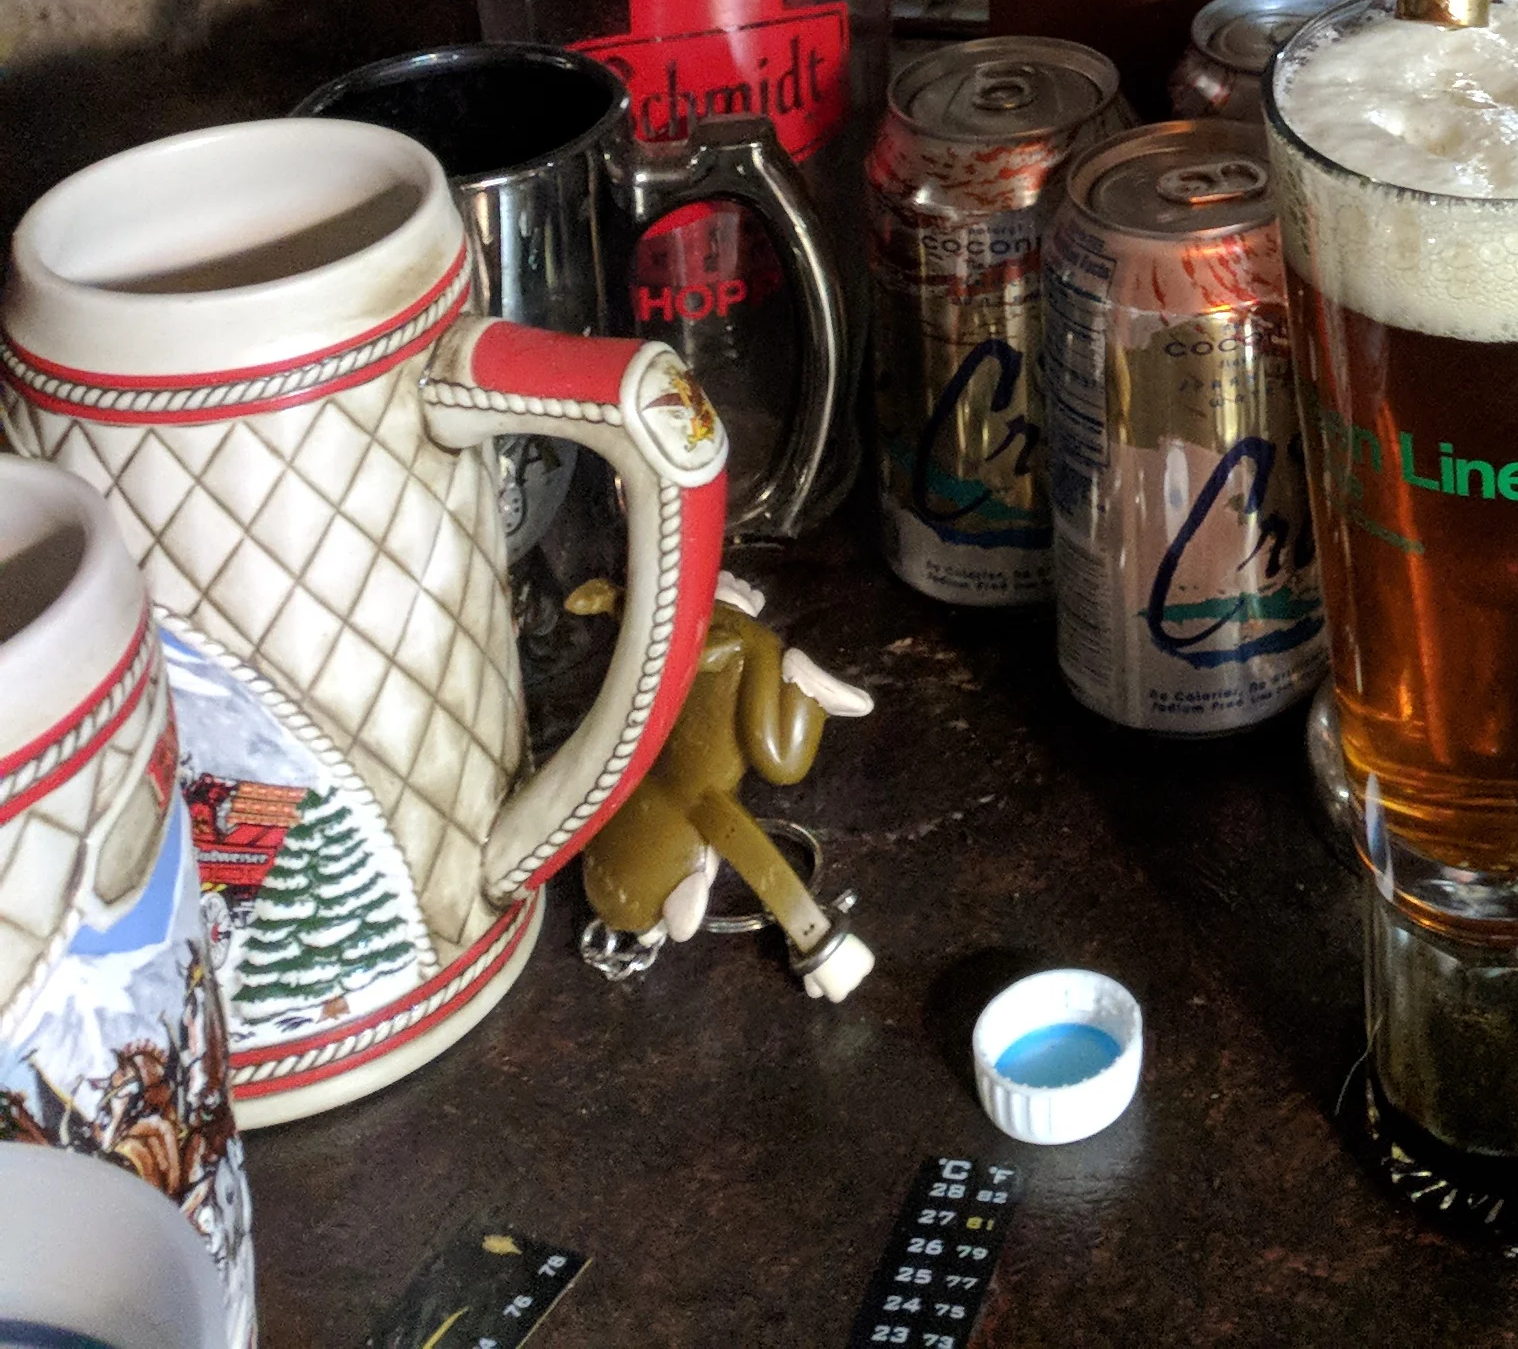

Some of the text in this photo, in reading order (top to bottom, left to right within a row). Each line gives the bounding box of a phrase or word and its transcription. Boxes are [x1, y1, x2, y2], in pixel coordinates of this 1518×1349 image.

[929, 1182, 1008, 1204] 28 82
[917, 1209, 995, 1231] 27 81
[907, 1238, 989, 1260] 26 79
[894, 1267, 979, 1290] 25 77
[502, 1295, 534, 1318] 76
[883, 1295, 966, 1319] 24 75
[871, 1325, 955, 1349] 23 73
